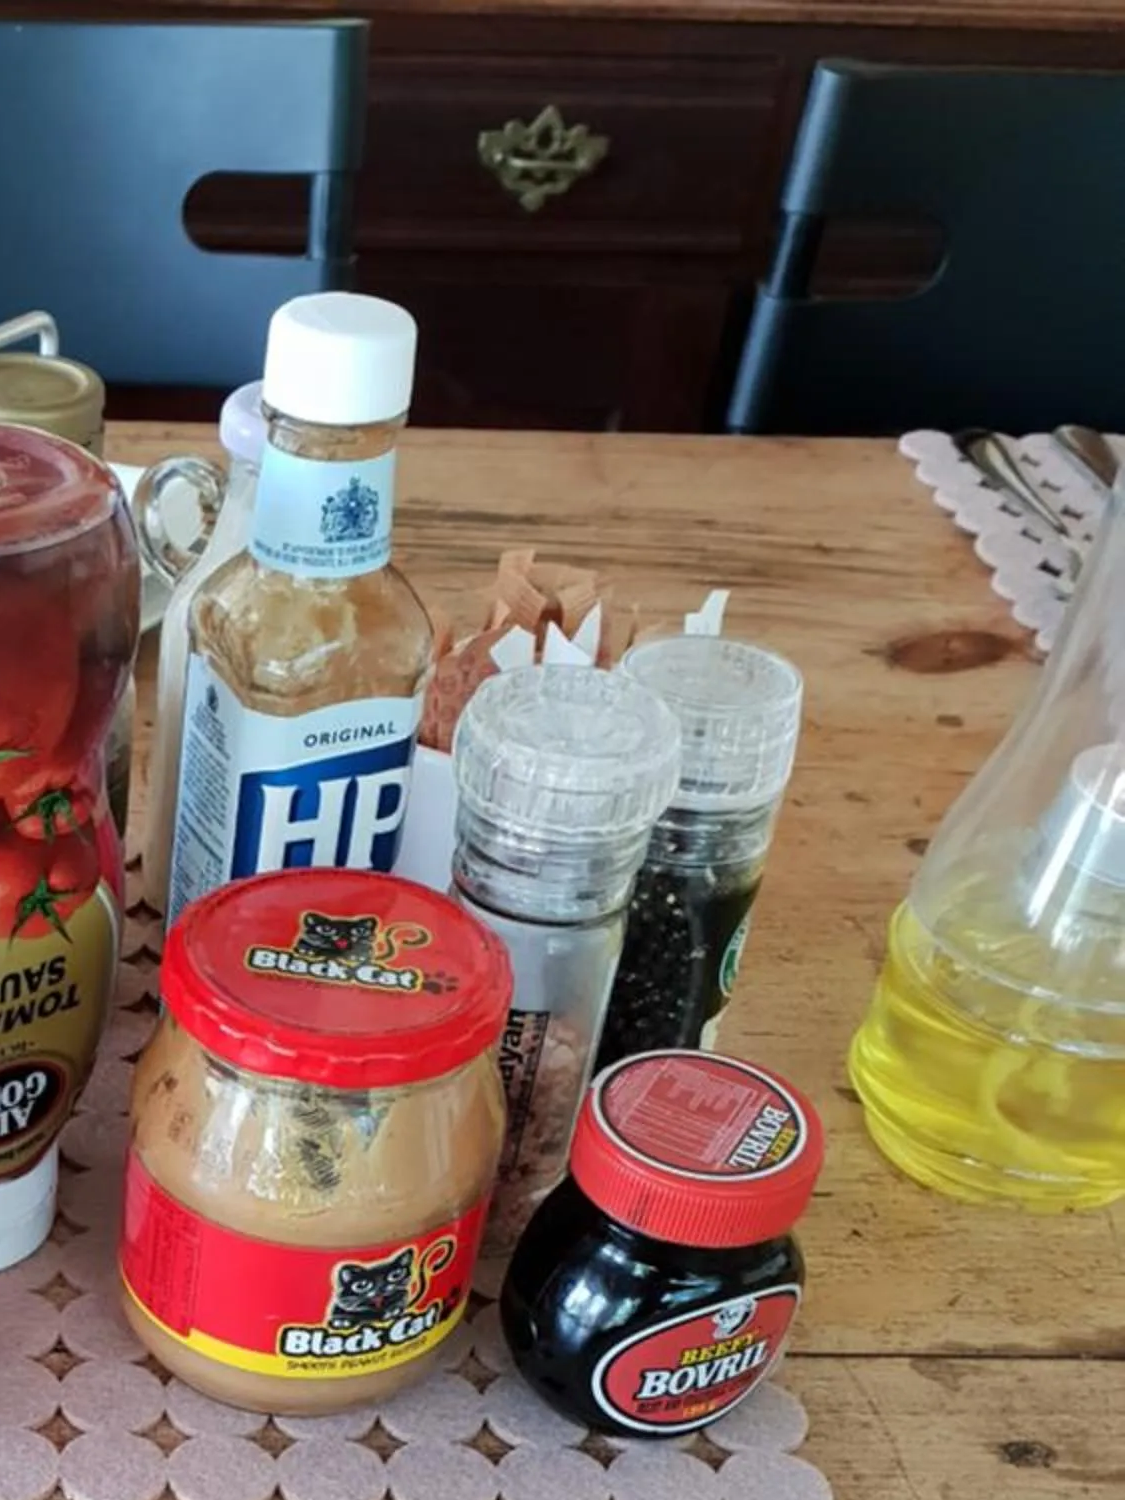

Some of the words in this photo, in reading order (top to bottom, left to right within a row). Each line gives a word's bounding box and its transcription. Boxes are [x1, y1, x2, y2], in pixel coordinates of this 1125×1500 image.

[303, 721, 398, 748] ORIGINAL
[256, 764, 412, 873] HP
[252, 949, 351, 982] Black
[354, 961, 419, 991] Cat
[726, 1104, 791, 1169] BOVRIL
[284, 1326, 383, 1356] Black
[388, 1306, 437, 1344] Cat
[635, 1340, 768, 1399] BOVRIL
